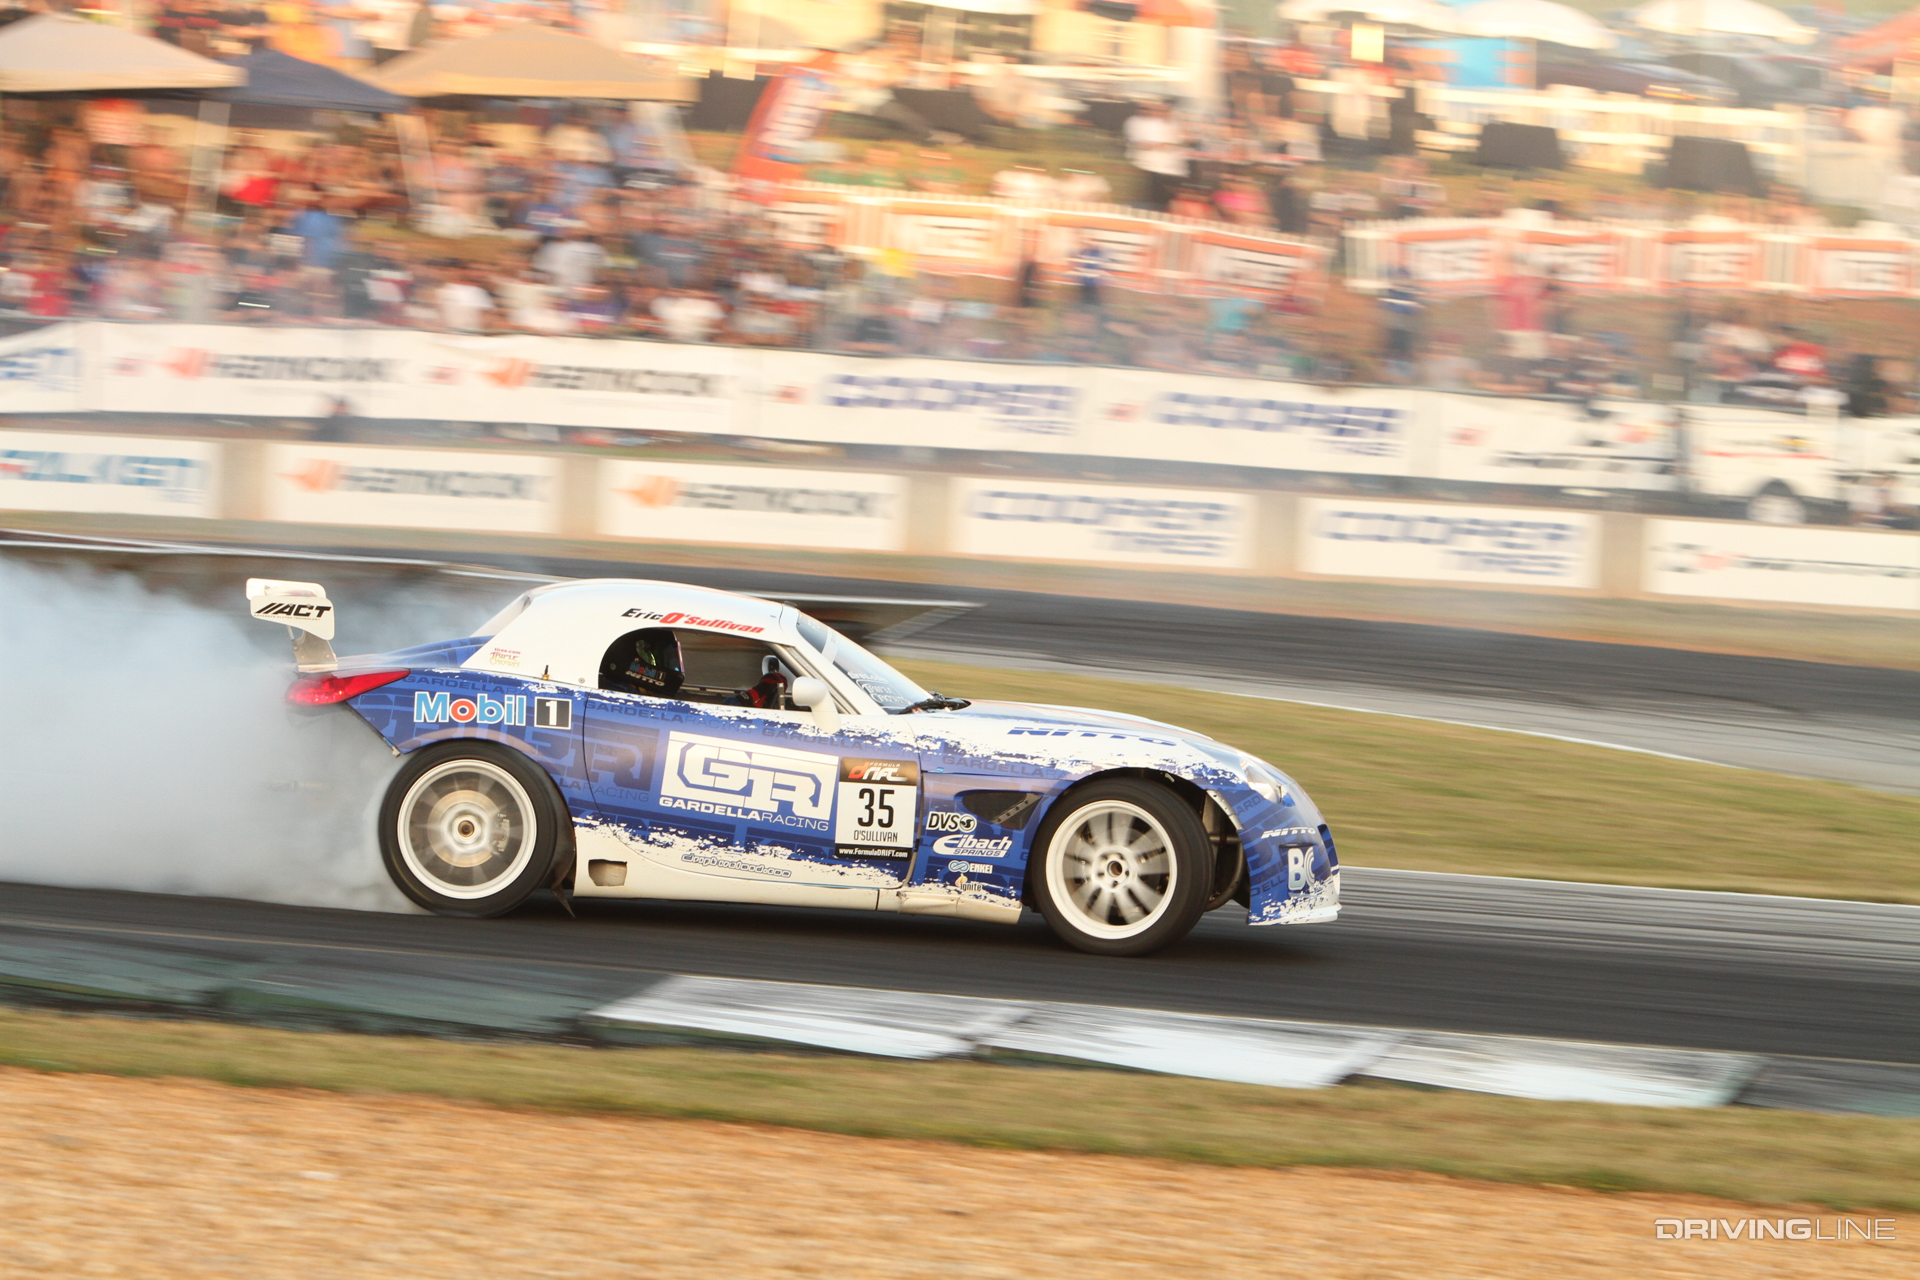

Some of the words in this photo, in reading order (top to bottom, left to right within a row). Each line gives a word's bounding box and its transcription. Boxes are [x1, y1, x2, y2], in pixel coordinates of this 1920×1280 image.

[414, 690, 527, 727] Mobil
[1007, 726, 1177, 747] NITTO
[857, 788, 895, 828] 35
[927, 812, 960, 831] DVS
[853, 829, 898, 843] O'SULLIVAN
[1261, 826, 1316, 839] NITTO
[933, 834, 1012, 854] Eibach
[839, 847, 908, 858] www.FormulaDRIFT.com
[953, 848, 1001, 857] SPRINGS
[968, 862, 994, 874] ENKEI
